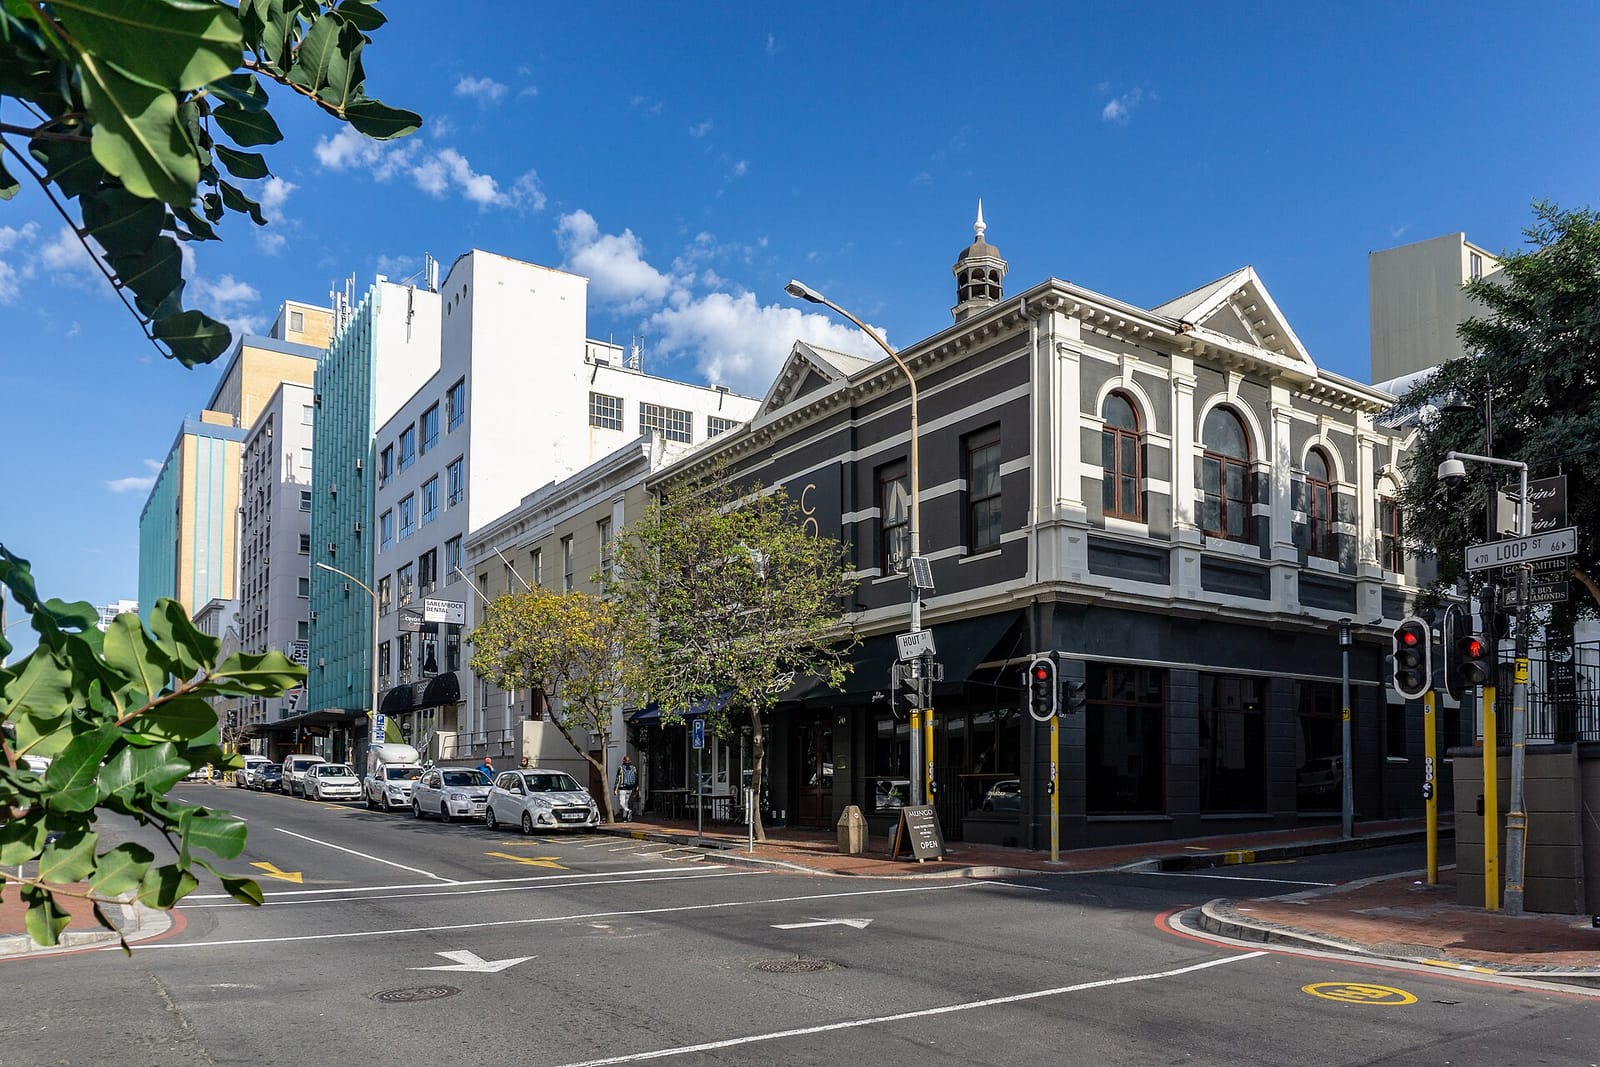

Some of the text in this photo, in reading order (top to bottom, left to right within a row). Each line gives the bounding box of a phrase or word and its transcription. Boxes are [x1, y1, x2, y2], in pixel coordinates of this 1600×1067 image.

[1479, 539, 1560, 564] 70 LOOP ST 66
[1505, 559, 1566, 574] GOSMITHS
[1537, 586, 1552, 594] BUY
[1530, 592, 1565, 602] IAMONDS
[426, 600, 464, 610] SAREMBOCK
[426, 606, 449, 614] DENTAL
[902, 634, 920, 647] HOUT
[695, 721, 701, 732] P
[908, 809, 933, 818] MUNGO
[920, 840, 938, 849] OPEN
